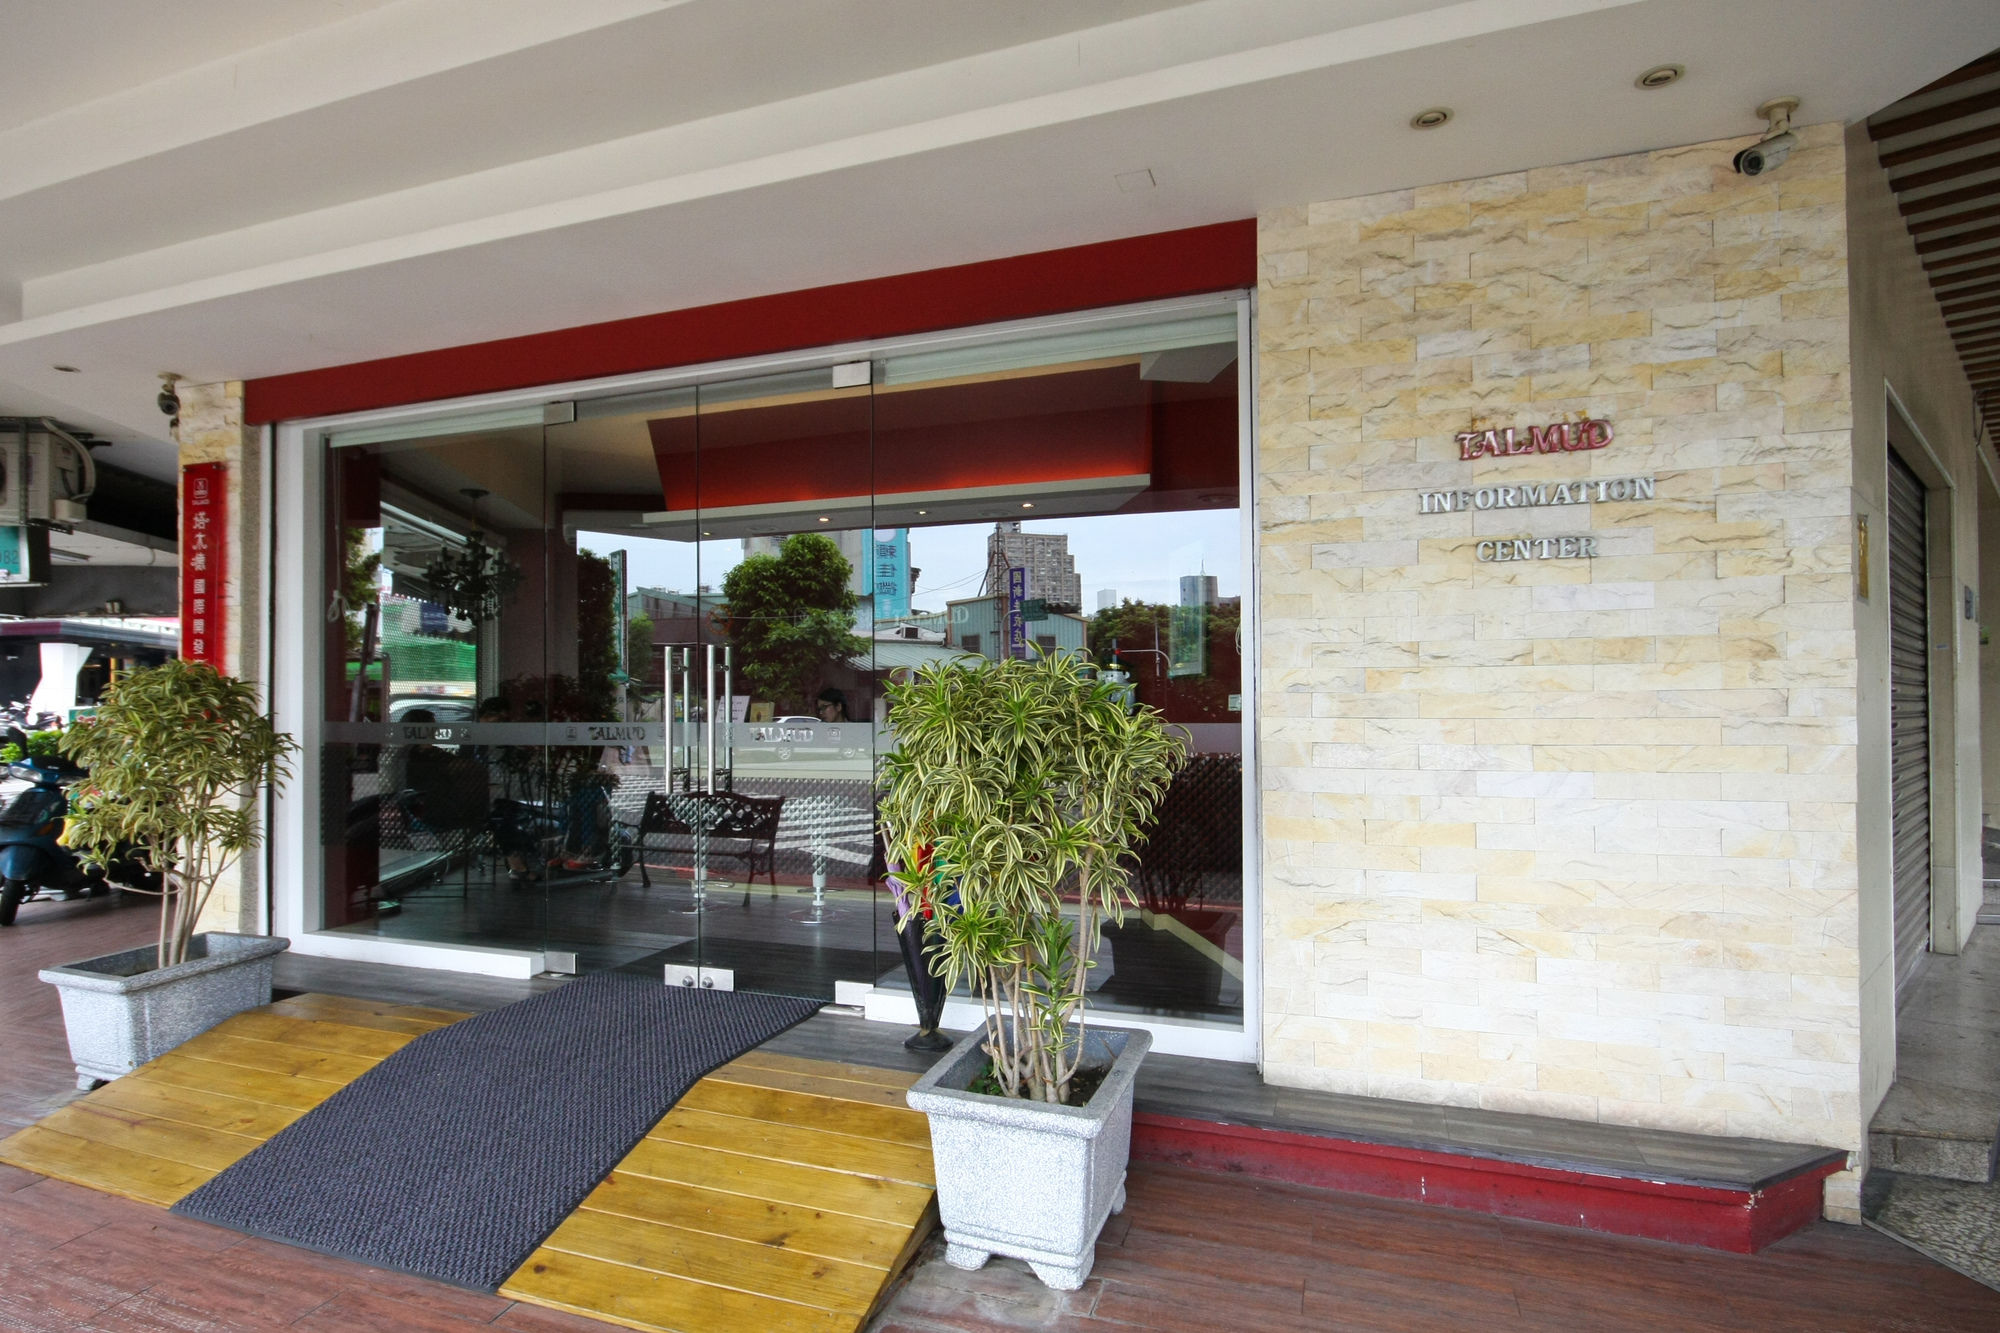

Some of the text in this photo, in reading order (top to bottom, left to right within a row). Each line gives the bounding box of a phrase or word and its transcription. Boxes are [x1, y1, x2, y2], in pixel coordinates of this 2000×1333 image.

[1456, 419, 1614, 460] TALMUD
[1419, 477, 1656, 514] INFORMATION
[1475, 536, 1598, 562] CENTER
[588, 726, 646, 741] TALMUD
[749, 727, 814, 742] TALMUD
